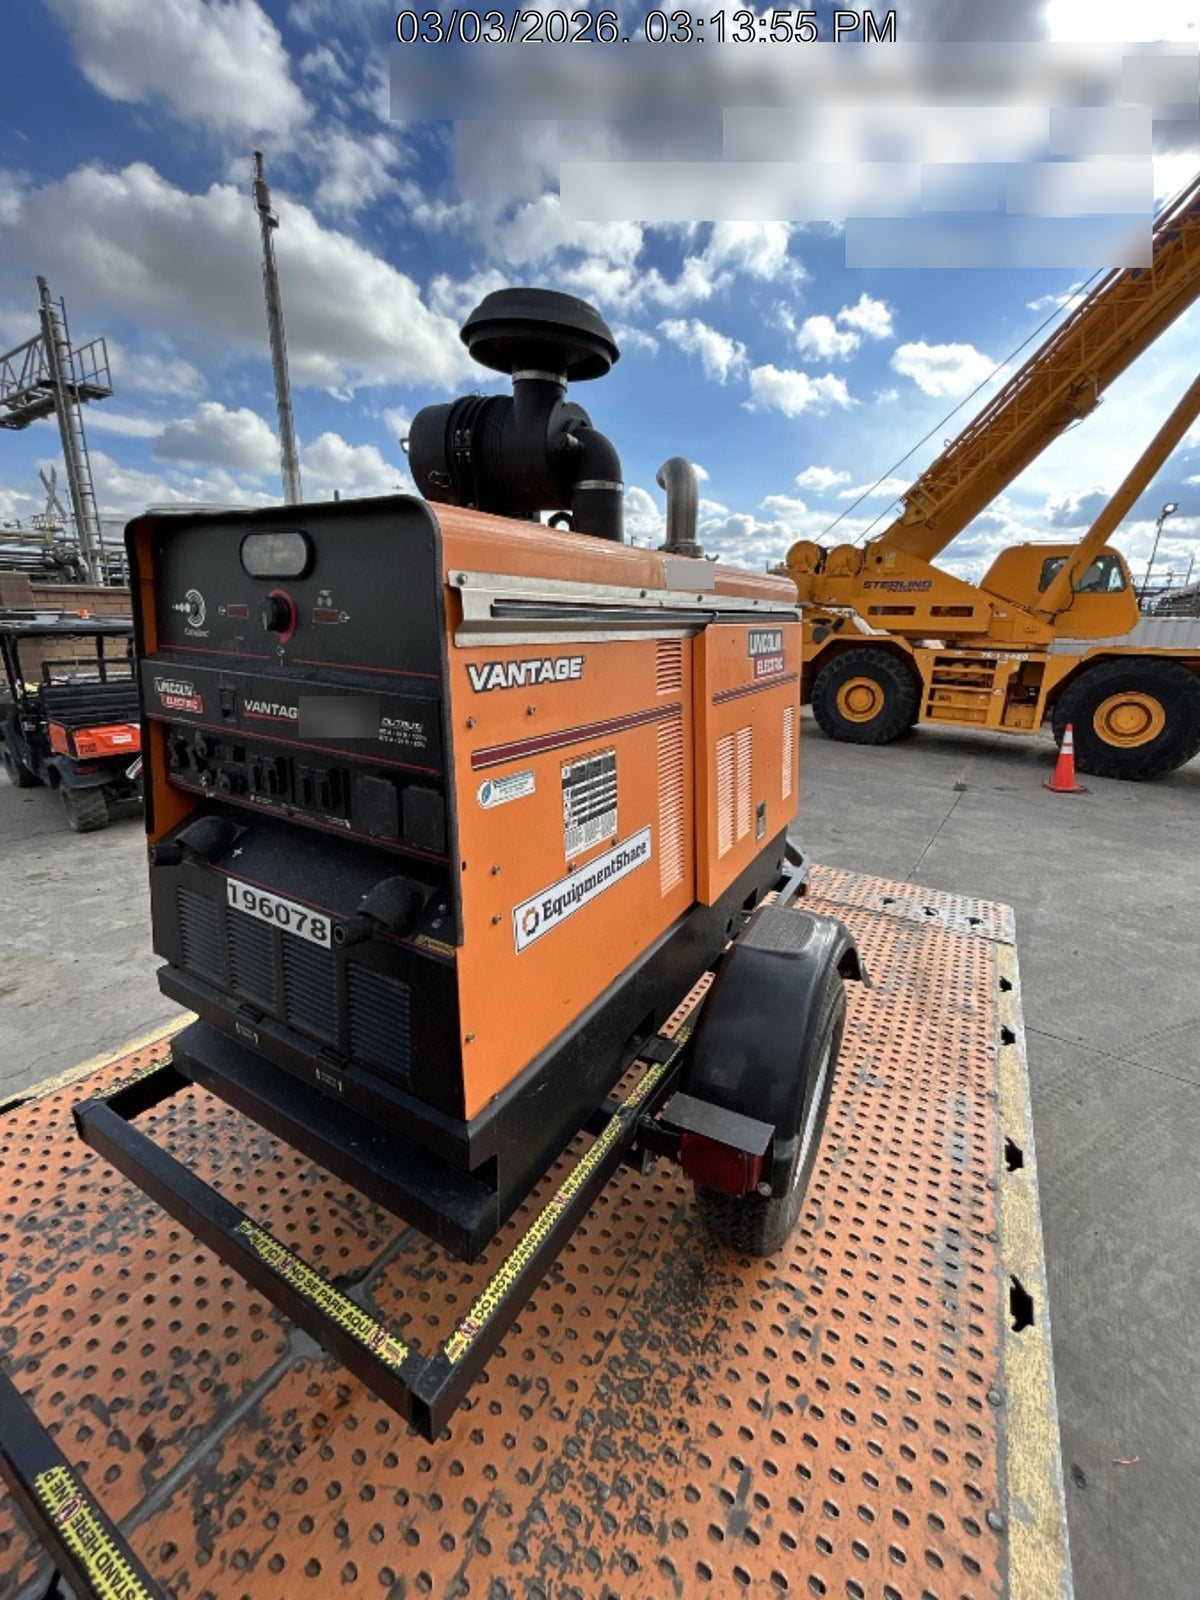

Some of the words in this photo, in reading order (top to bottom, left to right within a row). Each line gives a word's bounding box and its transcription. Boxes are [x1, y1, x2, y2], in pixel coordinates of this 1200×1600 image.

[467, 657, 584, 691] VANTAGE
[244, 700, 299, 719] VANTAG
[541, 841, 647, 922] EquipmentShare
[229, 881, 328, 943] 196078
[290, 1265, 306, 1281] NO
[303, 1278, 321, 1293] SE
[318, 1289, 347, 1315] PARE
[474, 1299, 491, 1320] DO
[490, 1271, 511, 1296] NOT
[508, 1232, 538, 1271] STAND
[50, 1478, 70, 1499] NE
[70, 1512, 102, 1558] HERE
[95, 1551, 137, 1600] STAND
